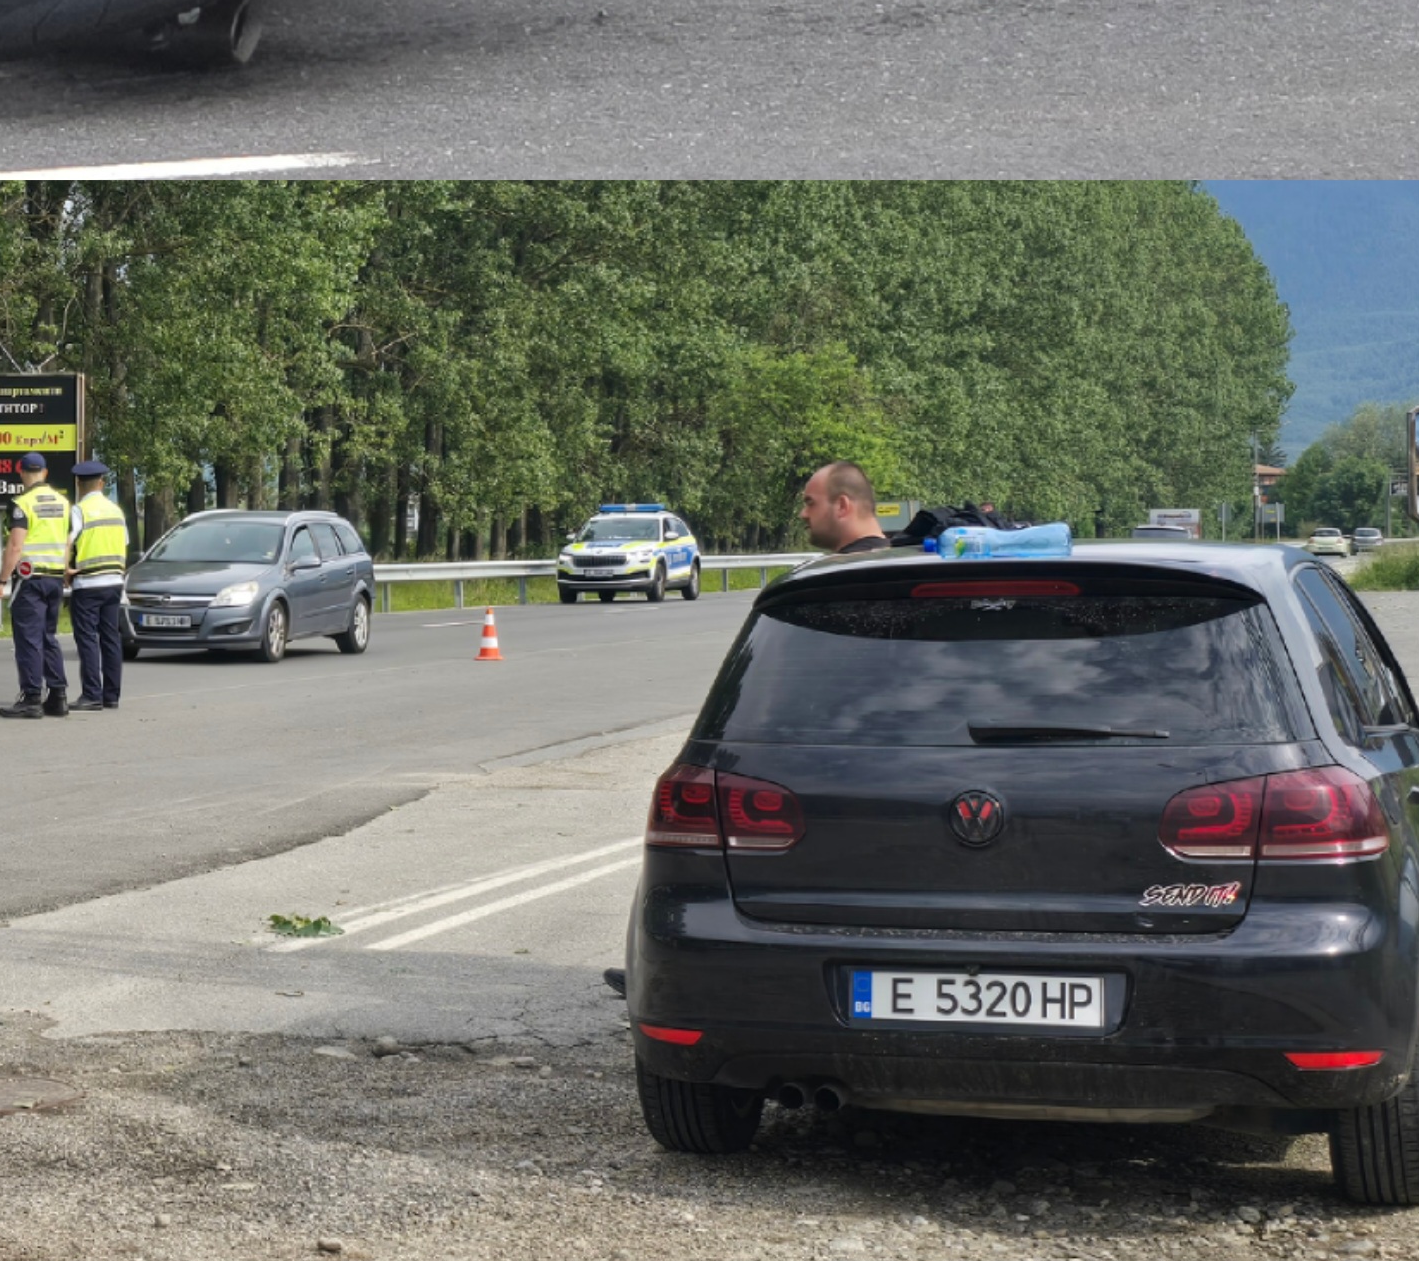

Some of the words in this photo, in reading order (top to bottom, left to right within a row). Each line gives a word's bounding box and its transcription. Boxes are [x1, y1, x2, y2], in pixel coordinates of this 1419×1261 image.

[1138, 883, 1206, 907] SEND
[854, 1000, 872, 1013] BG
[891, 977, 914, 1015] E
[935, 978, 1032, 1017] 5320
[1041, 981, 1093, 1020] HP
